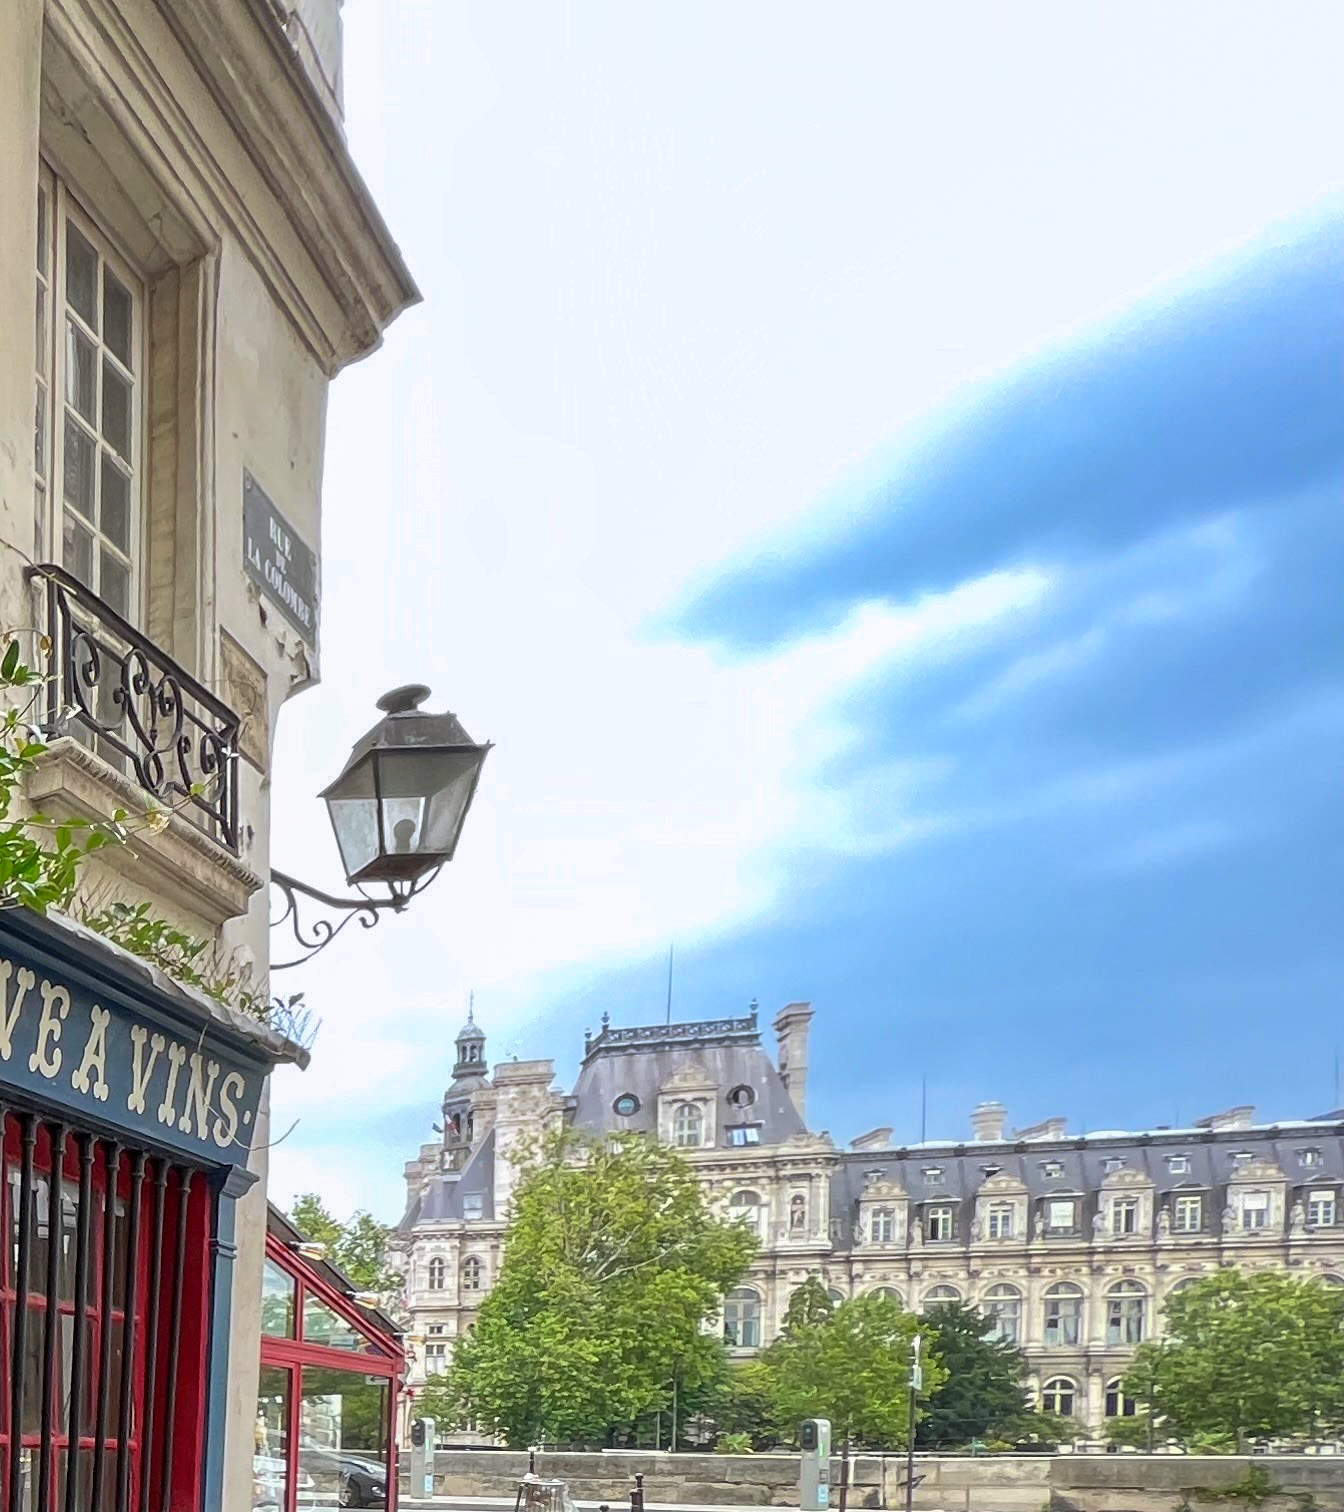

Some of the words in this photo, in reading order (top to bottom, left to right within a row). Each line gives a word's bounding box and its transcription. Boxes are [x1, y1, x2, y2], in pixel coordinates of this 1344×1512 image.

[269, 516, 292, 561] RUE
[275, 550, 287, 576] DE
[248, 536, 261, 571] LA
[264, 558, 312, 630] COLOMBE
[71, 1004, 110, 1101] A
[127, 1024, 246, 1147] VINS
